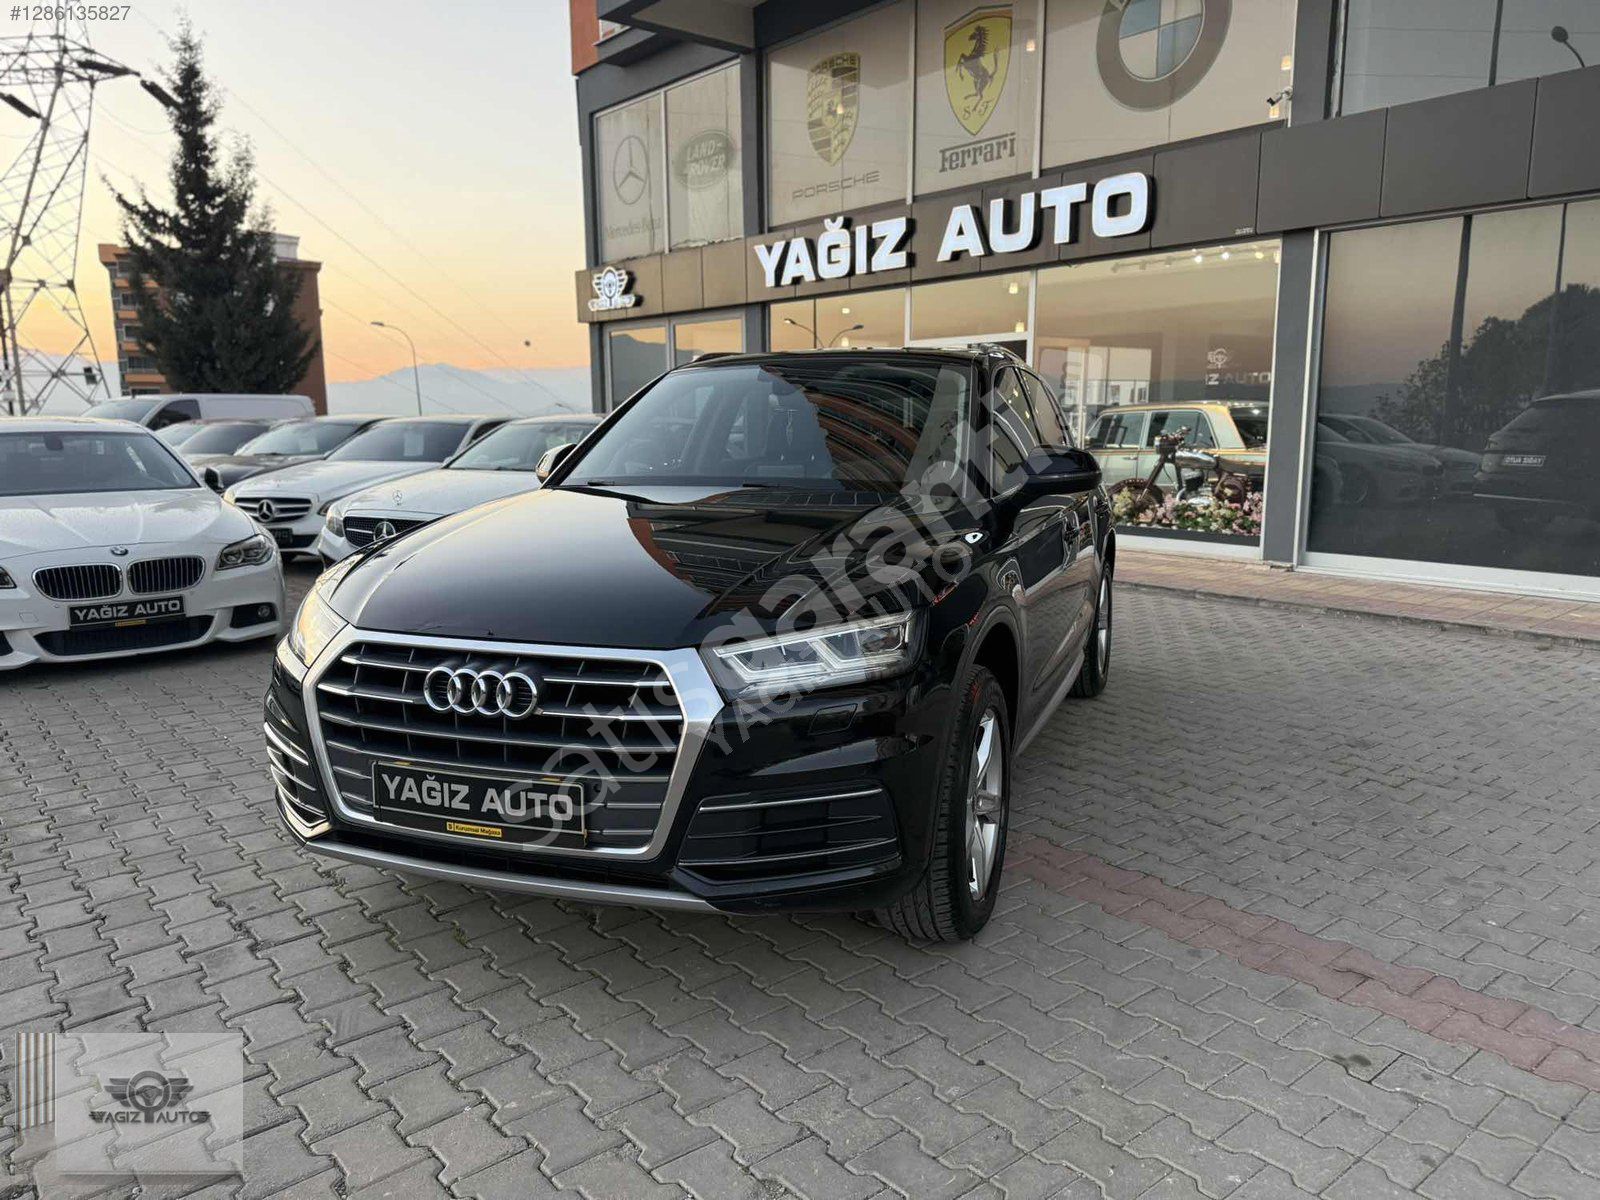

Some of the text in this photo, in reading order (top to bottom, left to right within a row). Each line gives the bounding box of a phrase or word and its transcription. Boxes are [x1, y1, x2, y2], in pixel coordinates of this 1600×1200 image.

[938, 131, 1016, 173] Ferrari
[792, 170, 881, 200] PORSCHE
[754, 172, 1149, 287] YAĞIZ AUTO
[74, 599, 181, 621] YAĞIZ AUTO
[381, 773, 574, 822] YAĞIZ AUTO
